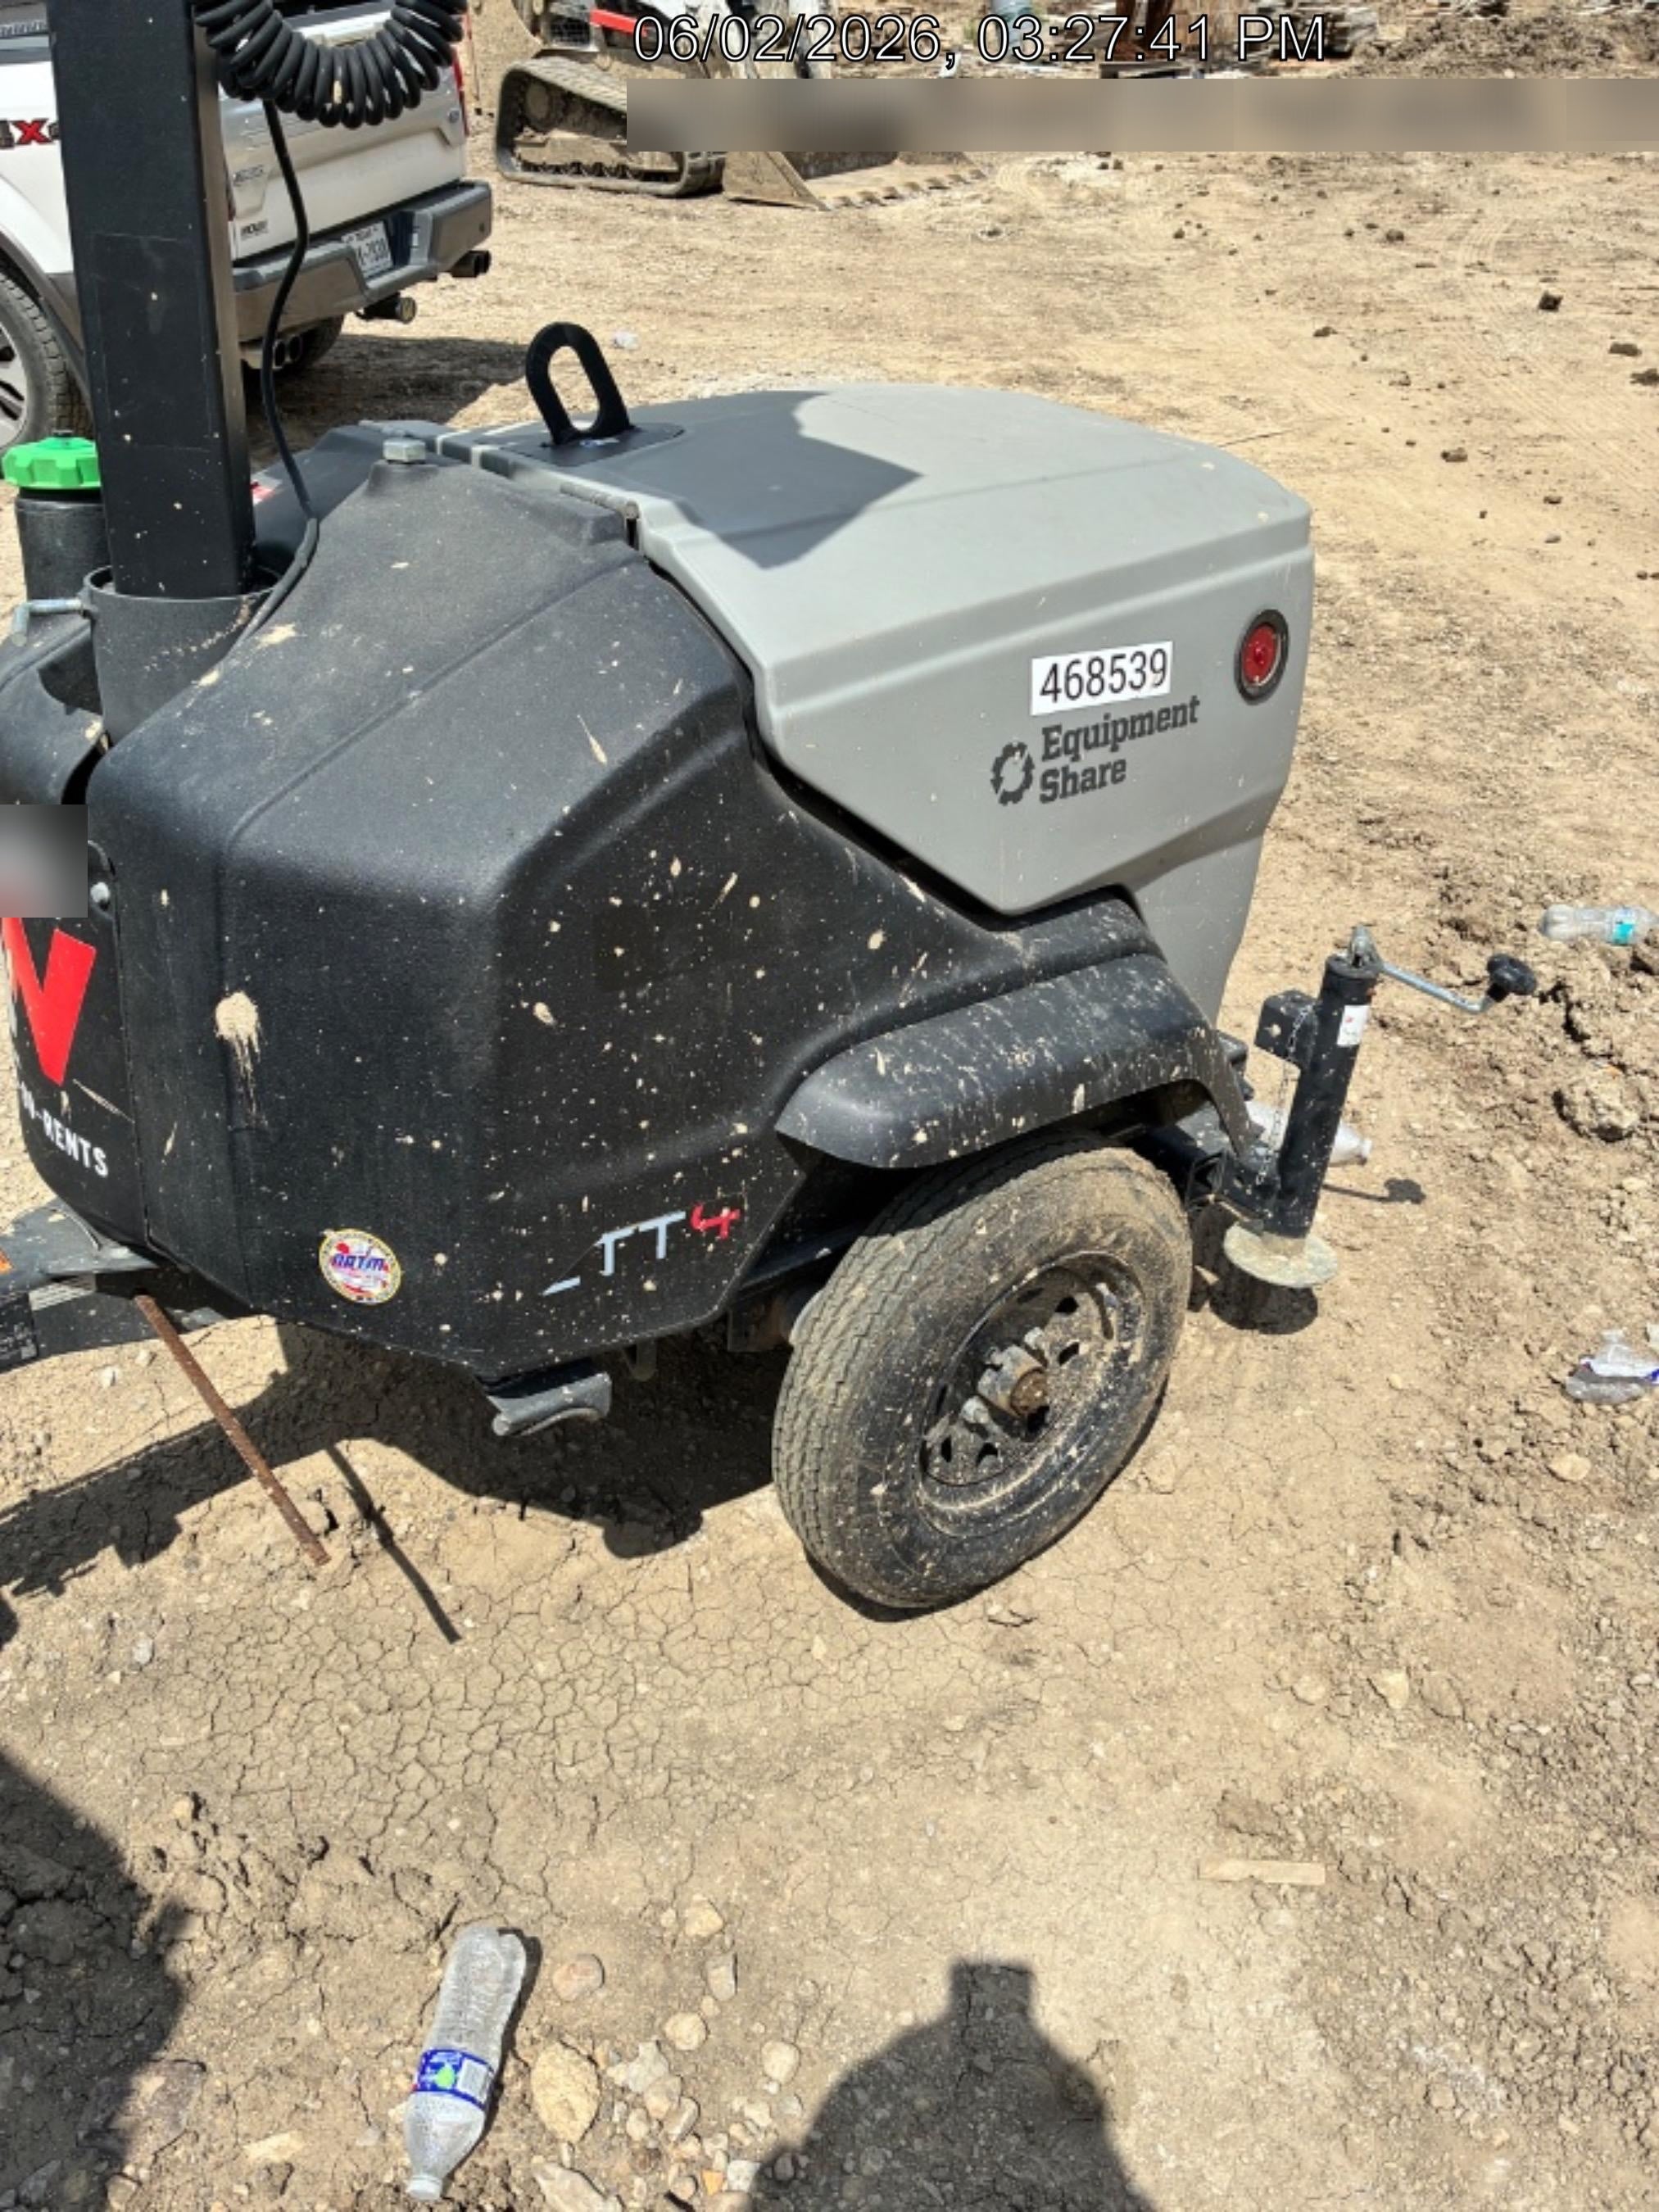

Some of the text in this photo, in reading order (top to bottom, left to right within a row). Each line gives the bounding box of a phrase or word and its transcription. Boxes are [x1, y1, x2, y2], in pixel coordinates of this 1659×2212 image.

[1040, 648, 1167, 704] 468539
[1041, 695, 1200, 762] Equipment
[1039, 759, 1127, 804] Share
